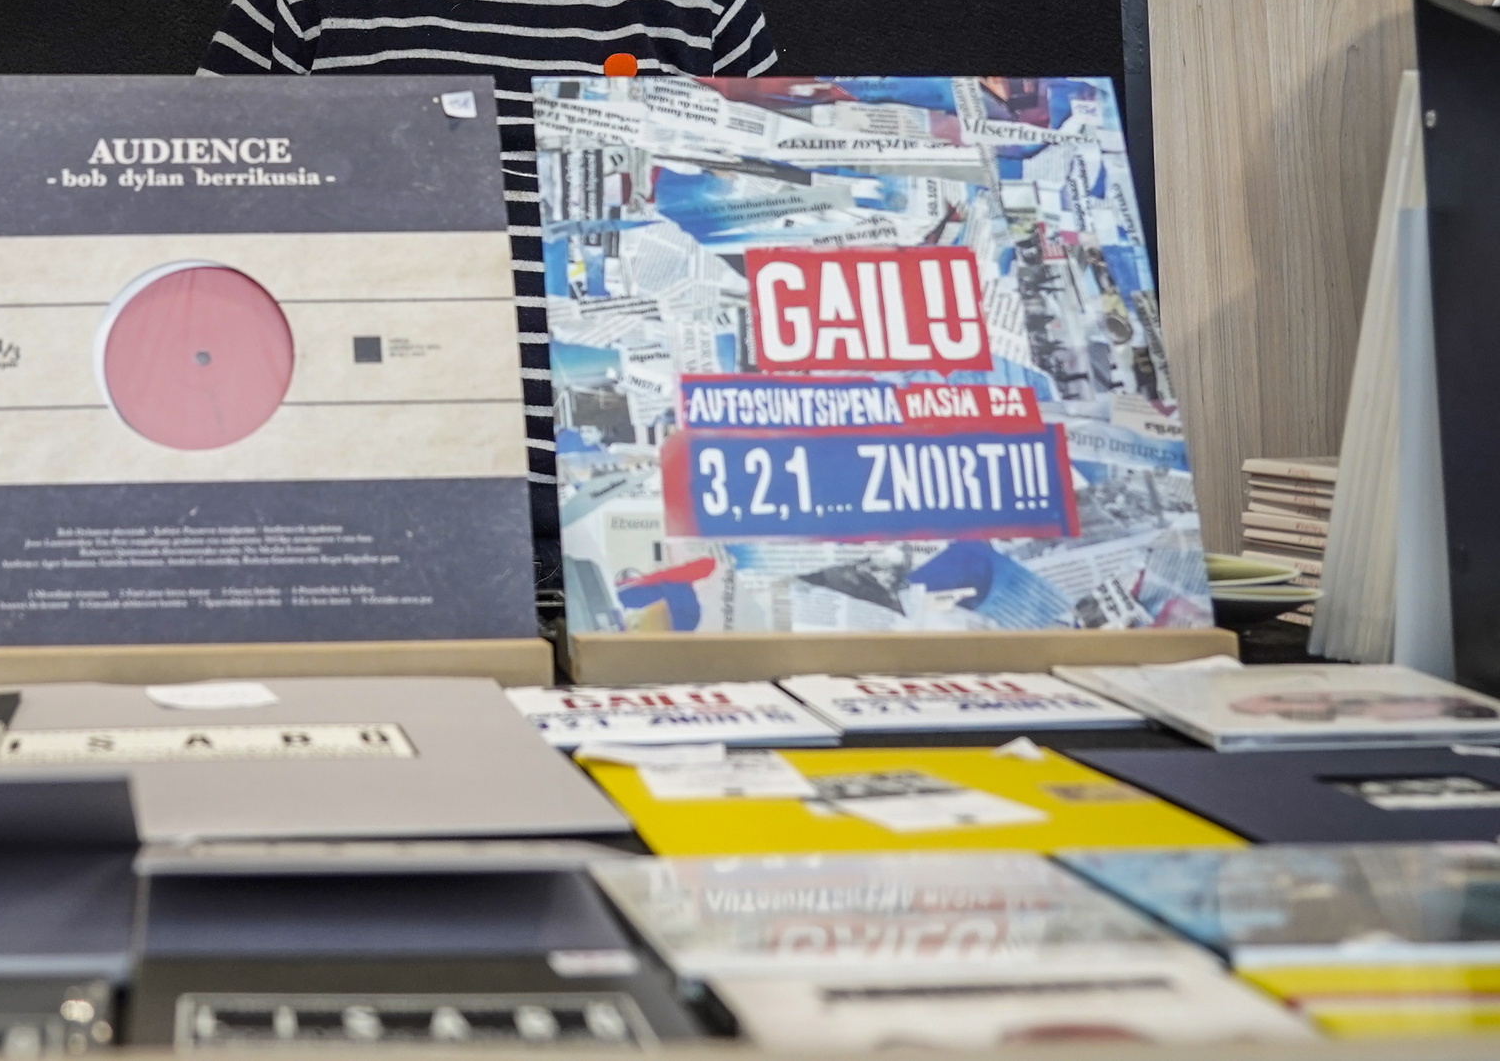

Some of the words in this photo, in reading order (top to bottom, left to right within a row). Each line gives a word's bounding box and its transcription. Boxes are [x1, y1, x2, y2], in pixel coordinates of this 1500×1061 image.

[88, 137, 292, 165] AUDIENCE
[118, 168, 185, 191] dylan
[756, 259, 981, 362] GAILU
[989, 386, 1027, 417] DA
[857, 441, 1050, 513] ZNORT!!!
